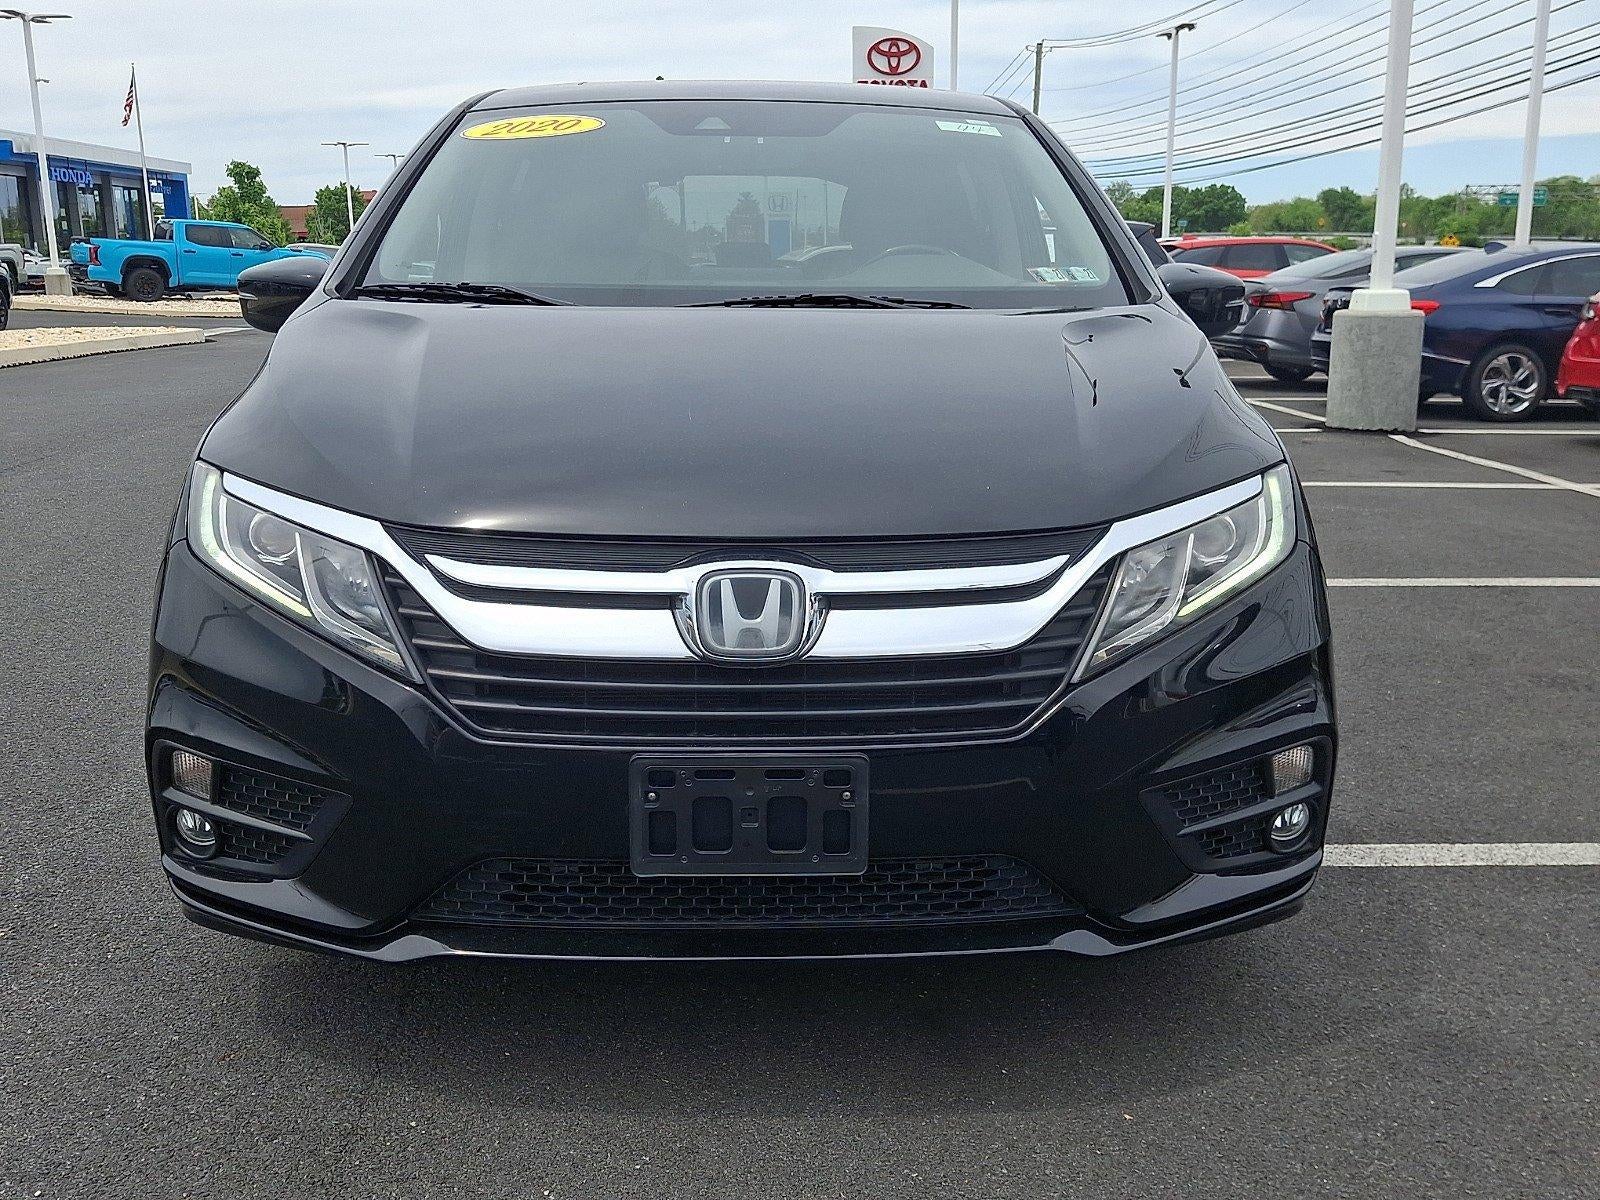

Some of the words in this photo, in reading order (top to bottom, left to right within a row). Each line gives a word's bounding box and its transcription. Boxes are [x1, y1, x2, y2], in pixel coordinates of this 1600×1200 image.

[857, 80, 928, 88] OTA
[480, 119, 582, 136] 2020
[50, 167, 93, 185] HONDA
